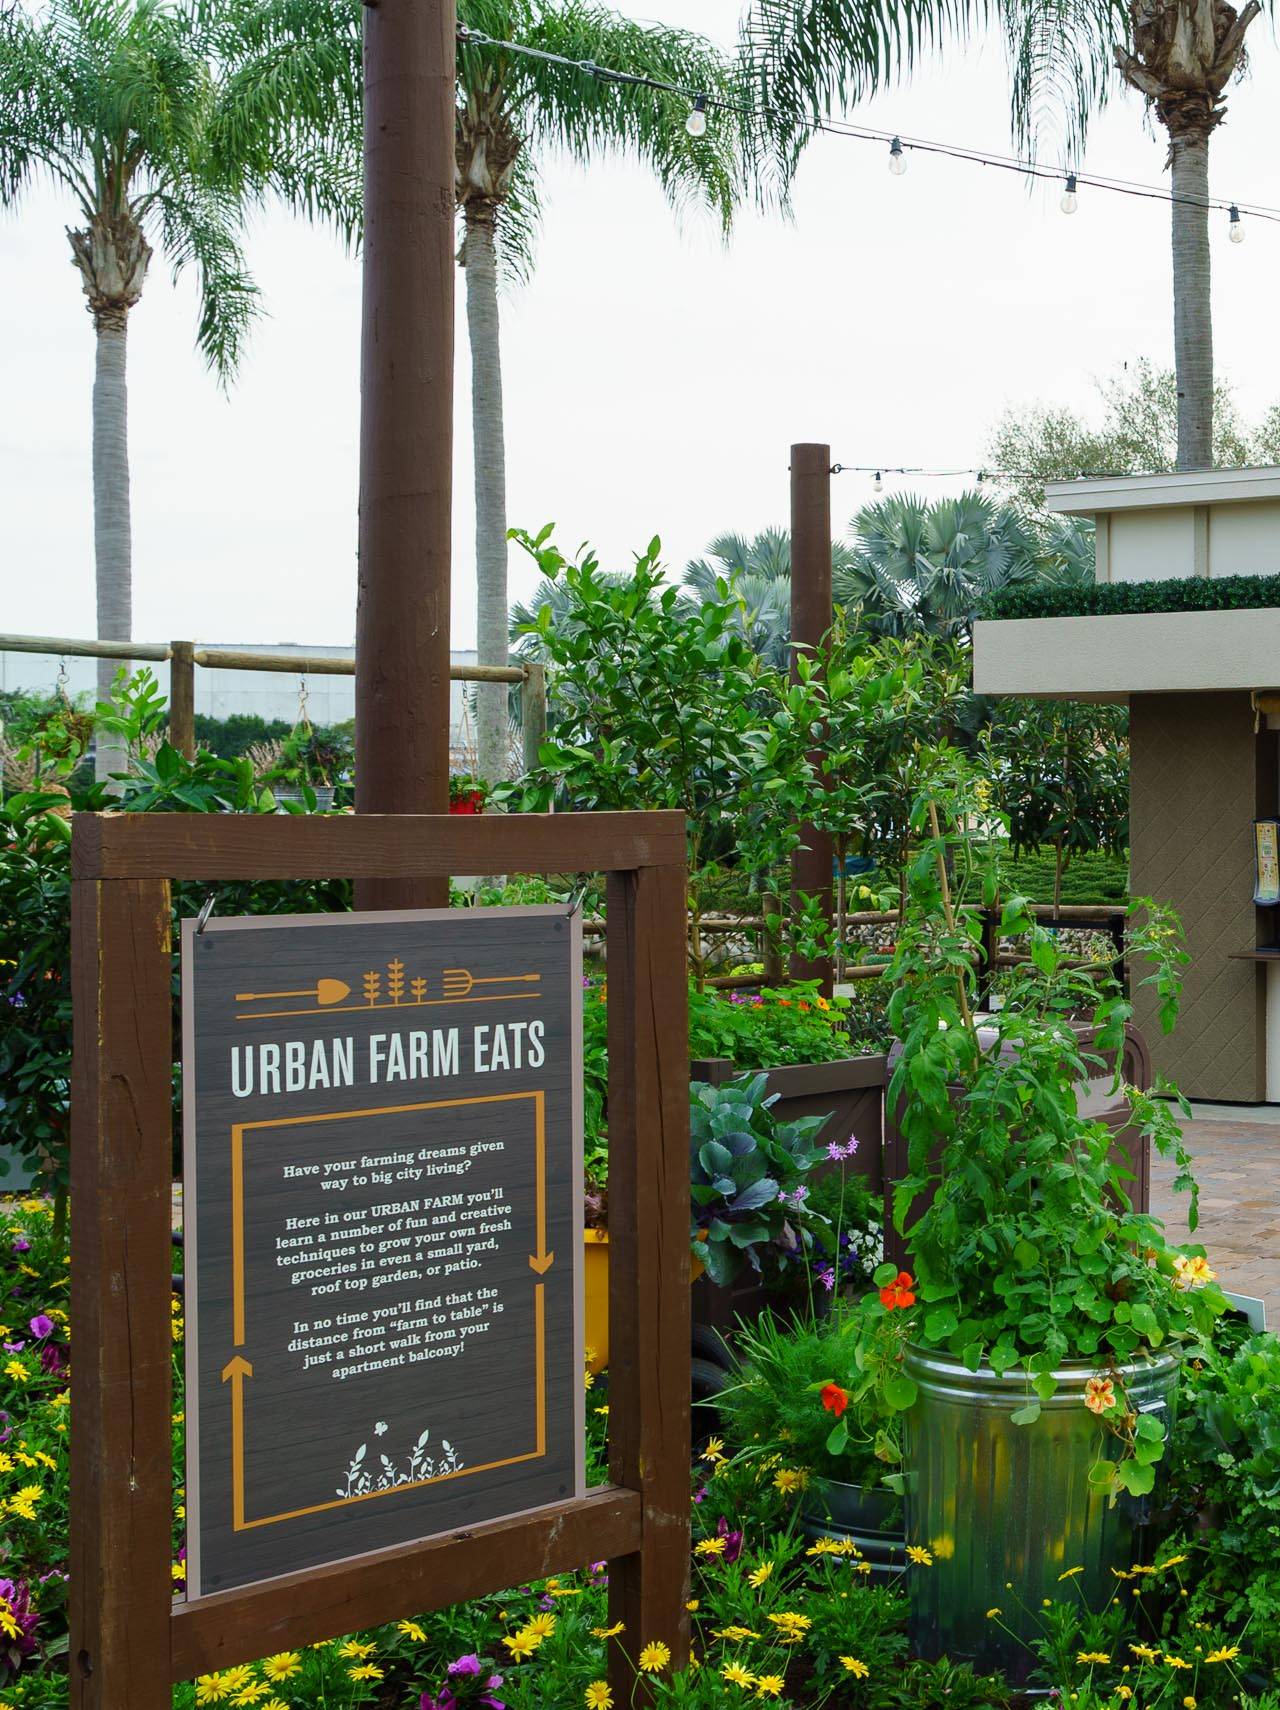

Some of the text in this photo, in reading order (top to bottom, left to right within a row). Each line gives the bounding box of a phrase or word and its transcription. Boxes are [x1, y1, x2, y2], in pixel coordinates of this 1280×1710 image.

[231, 1019, 546, 1098] URBAN FARM EATS
[283, 1141, 505, 1178] Have your farming dreams given
[320, 1160, 472, 1191] way to big city living?
[276, 1204, 512, 1249] learn a number of fun and creative
[286, 1217, 320, 1230] Here
[324, 1213, 339, 1224] in
[343, 1210, 367, 1221] our
[371, 1200, 420, 1217] URBAN
[423, 1193, 464, 1209] FARM
[276, 1219, 512, 1266] techniques to grow your own fresh
[291, 1237, 499, 1284] groceries in even a small yard,
[311, 1258, 482, 1296] roof top garden, or patio.
[288, 1333, 348, 1352] distance
[352, 1326, 386, 1340] from
[432, 1314, 446, 1324] to
[493, 1302, 504, 1313] is
[293, 1322, 309, 1334] In
[313, 1319, 332, 1330] no
[336, 1312, 368, 1325] time
[415, 1296, 442, 1311] find
[445, 1291, 473, 1305] that
[476, 1288, 498, 1299] the
[302, 1322, 490, 1369] just a short walk from your
[332, 1341, 464, 1379] apartment balcony!
